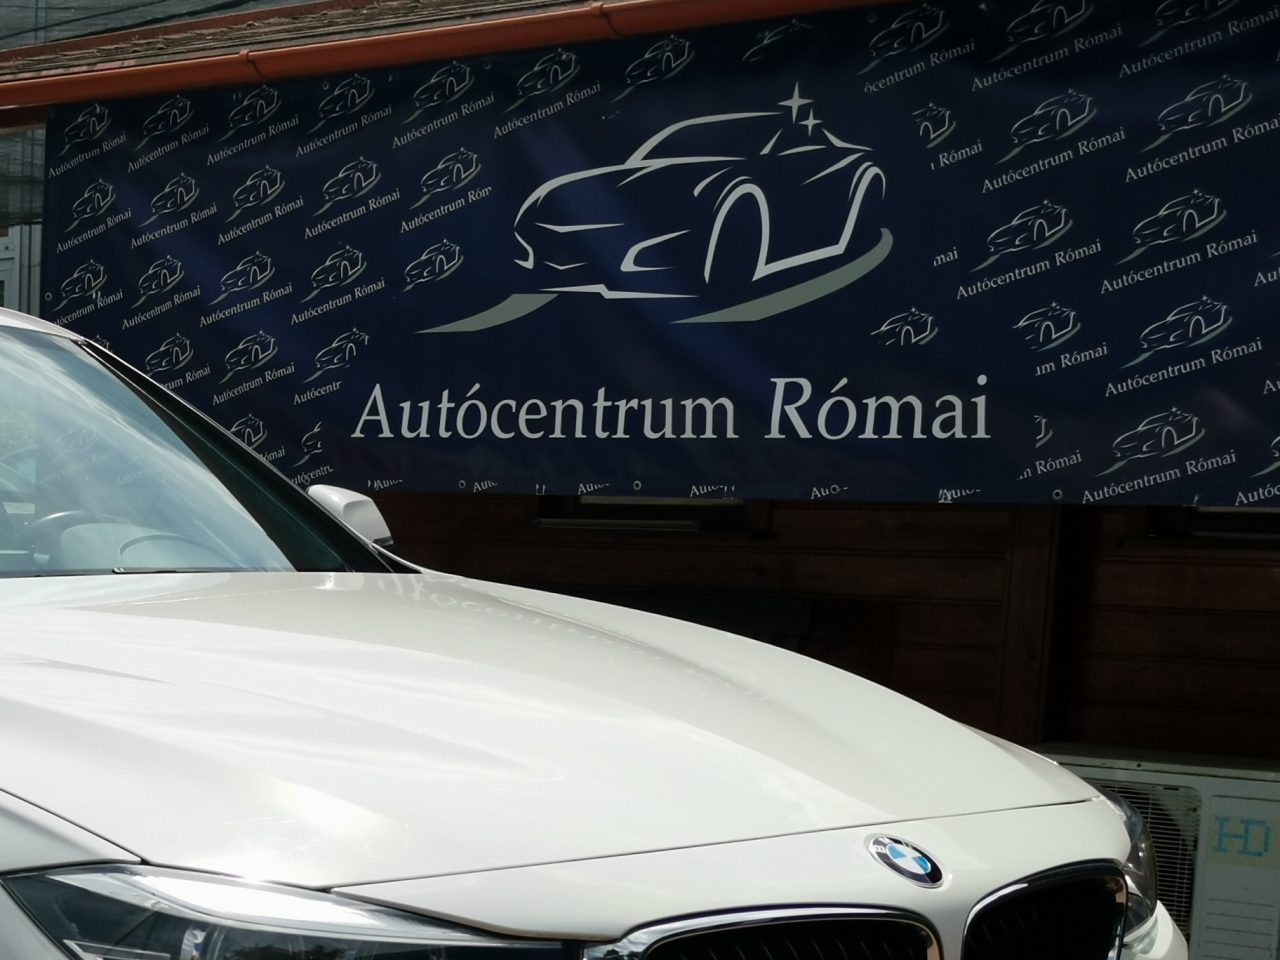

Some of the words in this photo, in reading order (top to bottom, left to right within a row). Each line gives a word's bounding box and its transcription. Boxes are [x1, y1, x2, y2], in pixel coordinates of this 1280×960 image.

[929, 39, 975, 67] Római
[971, 45, 1069, 91] Autócentrum
[1074, 23, 1123, 52] Római
[296, 123, 358, 158] Autócentrum
[361, 104, 392, 128] Római
[392, 111, 459, 149] Autócentrum
[461, 91, 495, 117] Római
[493, 103, 564, 139] Autócentrum
[566, 80, 601, 106] Római
[206, 132, 266, 166] Autócentrum
[269, 114, 299, 136] Római
[939, 139, 983, 167] Római
[981, 149, 1074, 193] Autócentrum
[1077, 127, 1126, 156] Római
[1125, 137, 1227, 183] Autócentrum
[1232, 112, 1280, 143] Róma
[56, 223, 106, 254] Autócentrum
[106, 207, 132, 229] Római
[130, 219, 188, 249] Autócentrum
[190, 202, 217, 224] Római
[218, 212, 273, 245] Autócentrum
[274, 195, 304, 219] Római
[304, 206, 366, 240] Autócentrum
[369, 187, 401, 211] Római
[400, 198, 466, 233] Autócentrum
[957, 260, 1051, 300] Autócentrum
[1055, 238, 1102, 268] Római
[1101, 251, 1201, 295] Autócentrum
[1206, 229, 1258, 259] Római
[53, 304, 95, 328] utócentrum
[97, 289, 123, 310] Római
[122, 302, 172, 330] Autócentrum
[173, 285, 201, 306] Római
[199, 297, 260, 328] Autócentrum
[263, 282, 293, 303] Római
[290, 293, 352, 326] Autócentrum
[354, 277, 385, 300] Római
[186, 364, 211, 383] Római
[1061, 342, 1108, 368] Római
[1105, 357, 1206, 397] Autócentrum
[1211, 337, 1263, 364] Római
[212, 376, 263, 406] Autócentrum
[264, 362, 295, 384] Római
[351, 382, 739, 440] Autócentrum
[764, 374, 991, 440] Római
[1035, 450, 1082, 474] Római
[1081, 468, 1180, 504] Autócentrum
[1186, 449, 1237, 475] Római
